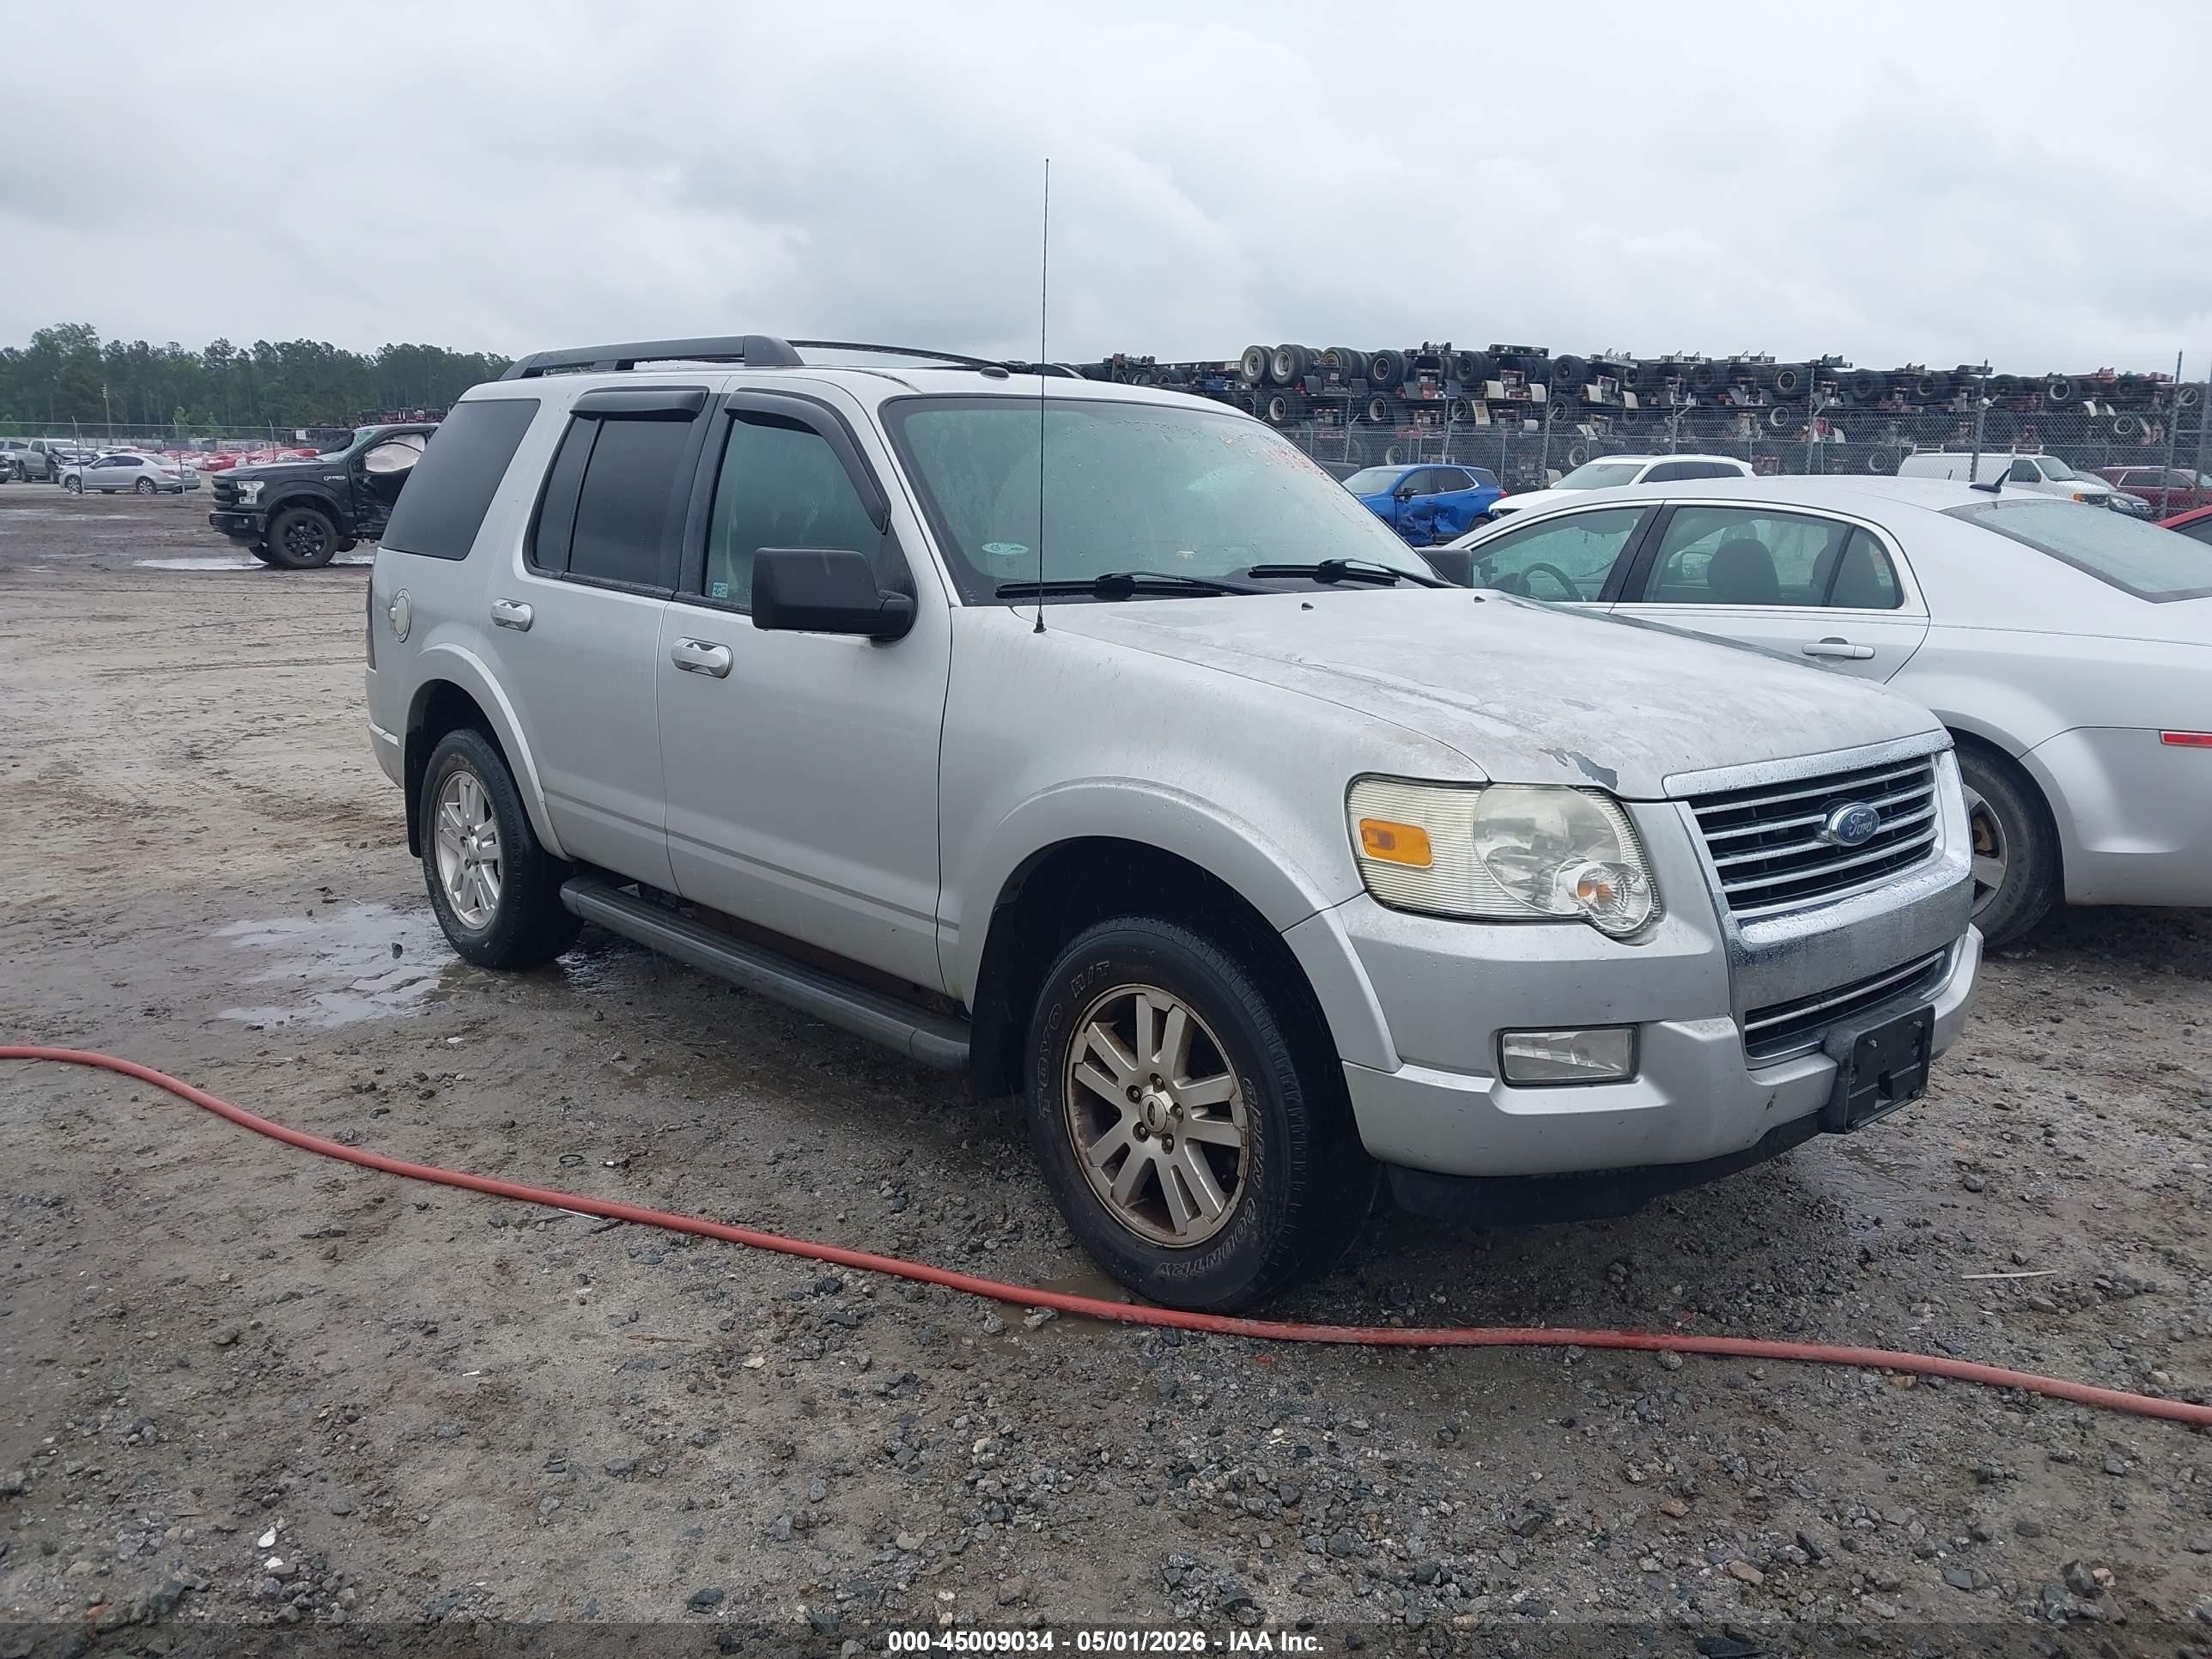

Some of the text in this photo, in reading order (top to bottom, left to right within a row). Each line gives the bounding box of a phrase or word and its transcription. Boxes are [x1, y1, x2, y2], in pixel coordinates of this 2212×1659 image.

[1848, 811, 1874, 837] Ford
[1037, 1003, 1064, 1120] TOYO
[1155, 1077, 1266, 1279] OPEN COUNTRY
